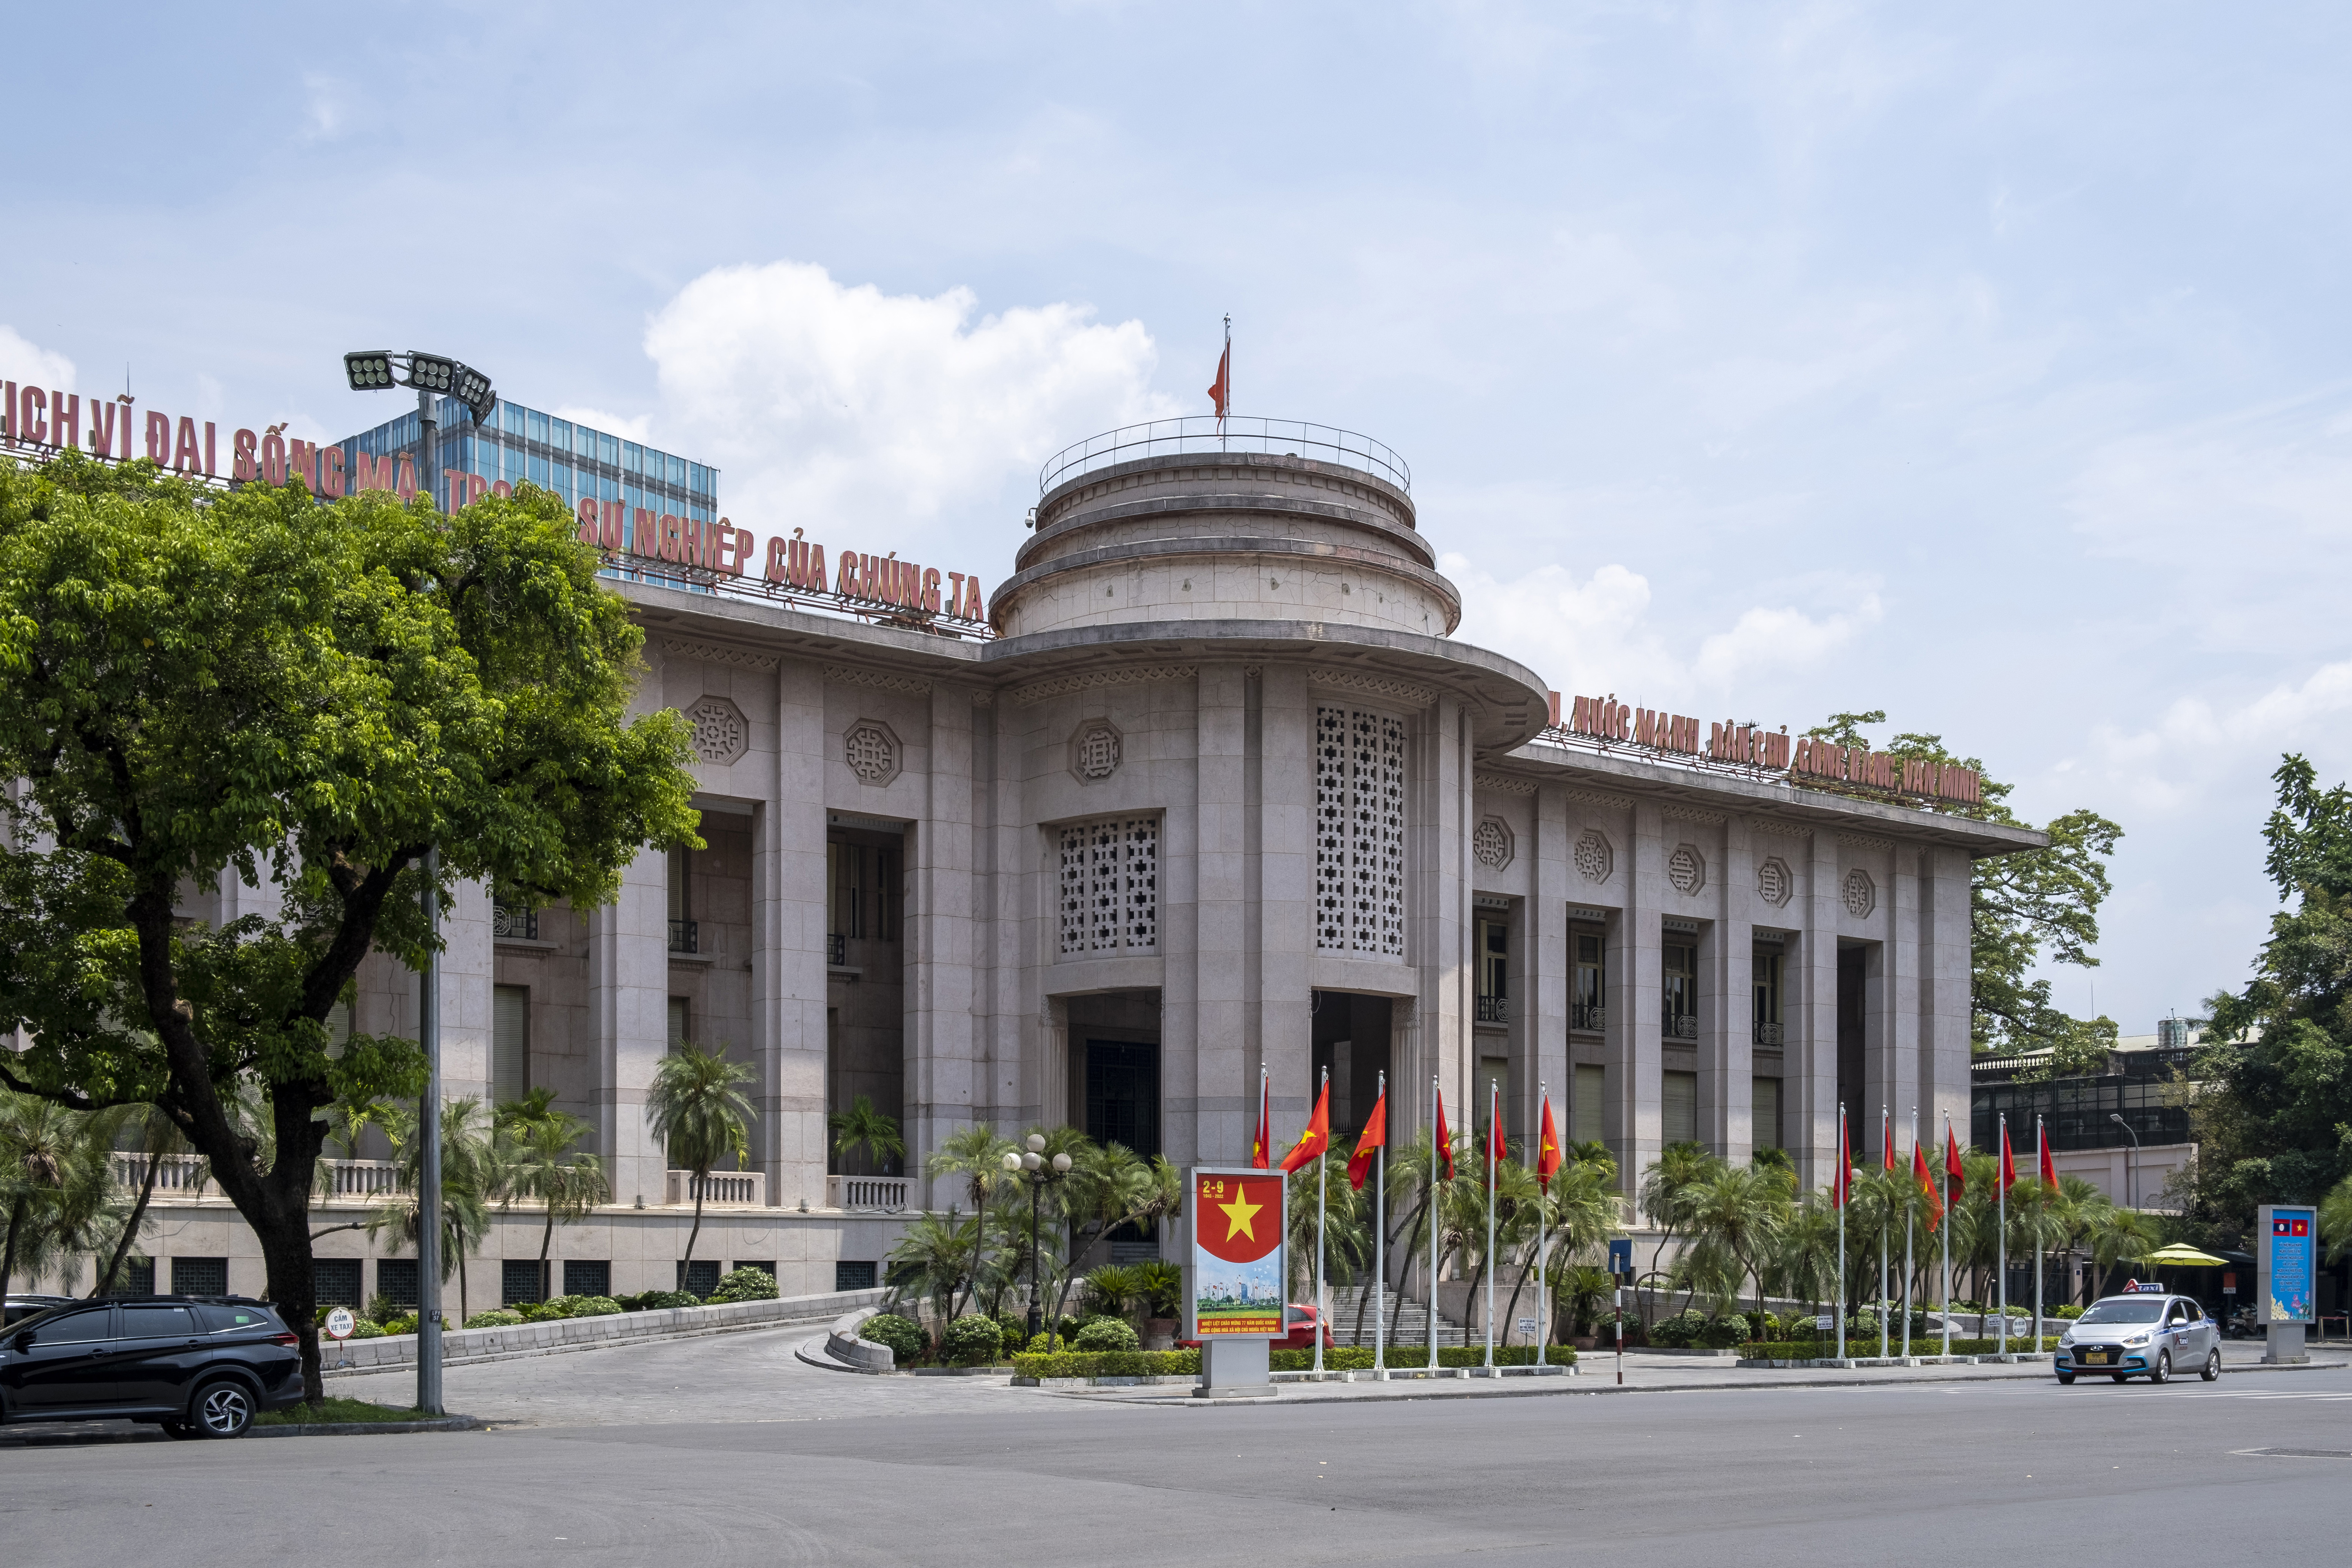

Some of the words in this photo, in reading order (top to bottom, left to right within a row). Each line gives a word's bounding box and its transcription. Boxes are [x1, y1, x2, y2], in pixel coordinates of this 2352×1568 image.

[0, 379, 80, 449] ỊCH
[91, 394, 135, 459] VĨ
[146, 410, 215, 481] ĐẠI
[234, 422, 345, 497] SỐNG
[579, 497, 626, 558] SỰ
[633, 508, 754, 581] NGHIỆP
[766, 527, 828, 592] CỦA
[840, 551, 941, 612] CHÚNG
[948, 571, 984, 621] TA
[1574, 693, 1630, 740] NƯỚC
[1711, 719, 1750, 763] DÂN
[1797, 735, 1846, 779] CÔNG
[334, 1313, 347, 1322] CẤM
